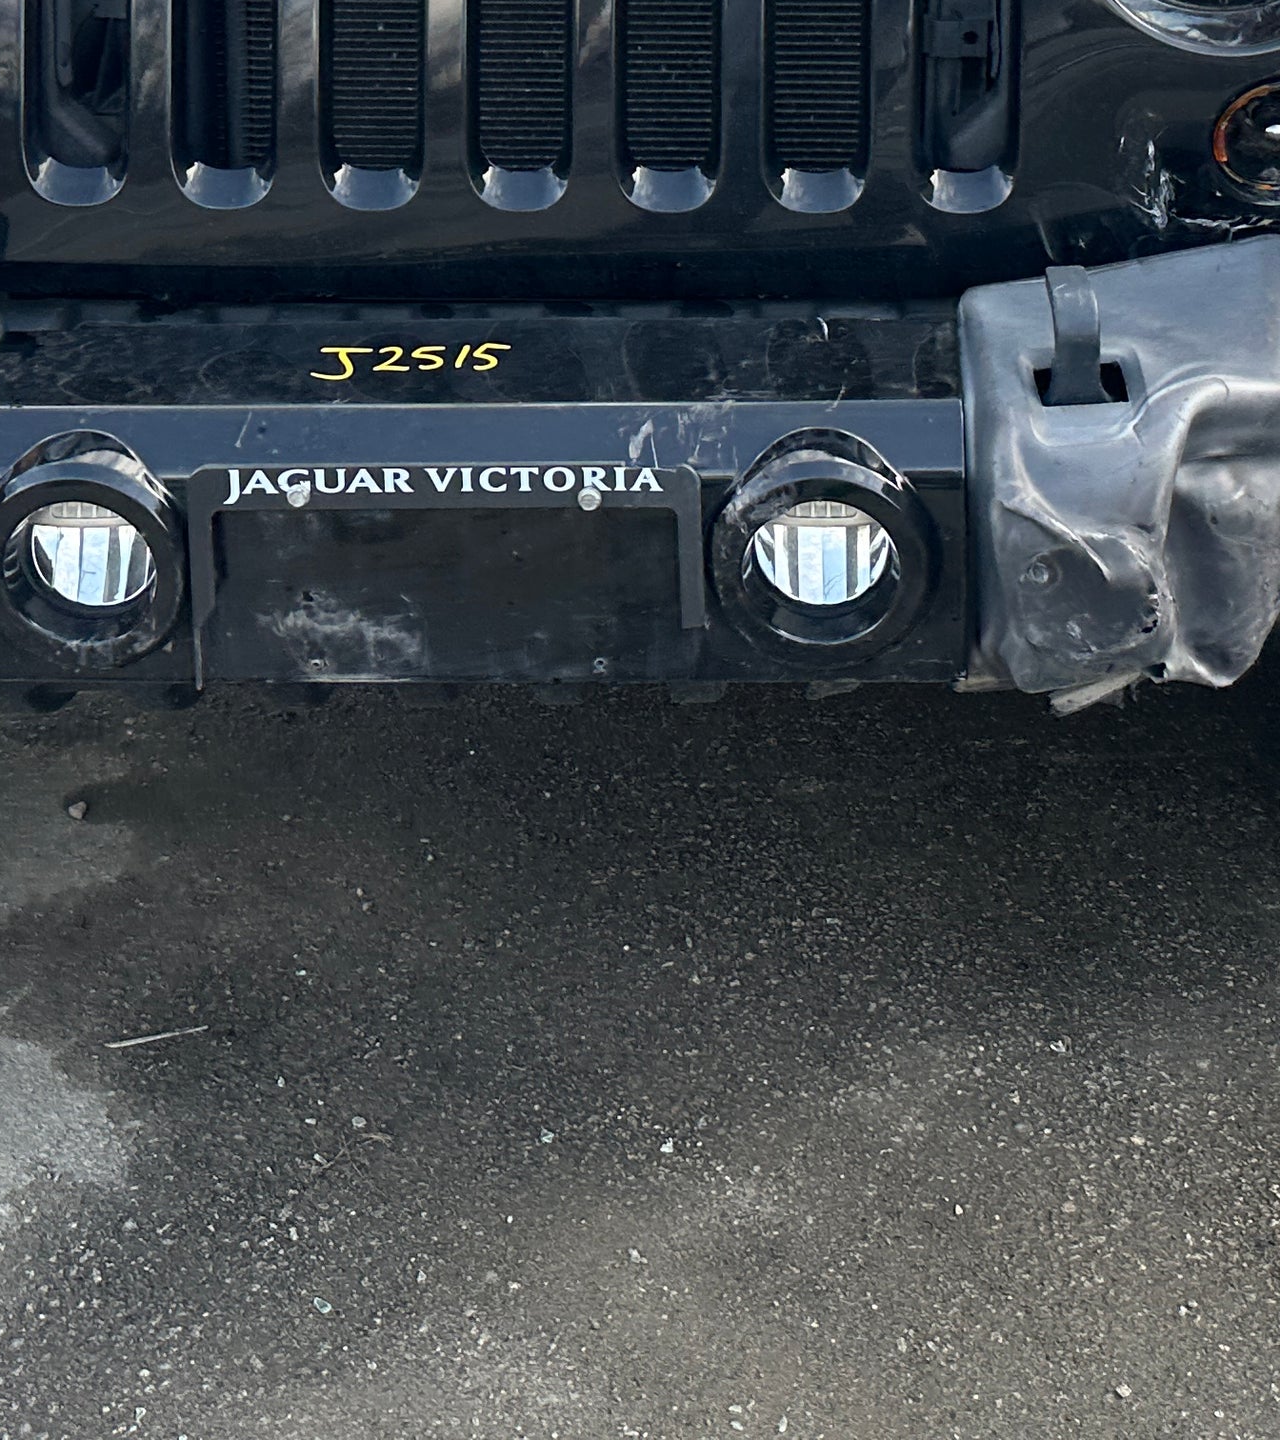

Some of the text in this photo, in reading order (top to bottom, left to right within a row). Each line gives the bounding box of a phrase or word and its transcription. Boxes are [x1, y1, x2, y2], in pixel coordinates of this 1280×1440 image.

[310, 343, 512, 381] J2515
[223, 466, 664, 505] JAGUAR VICTORIA
